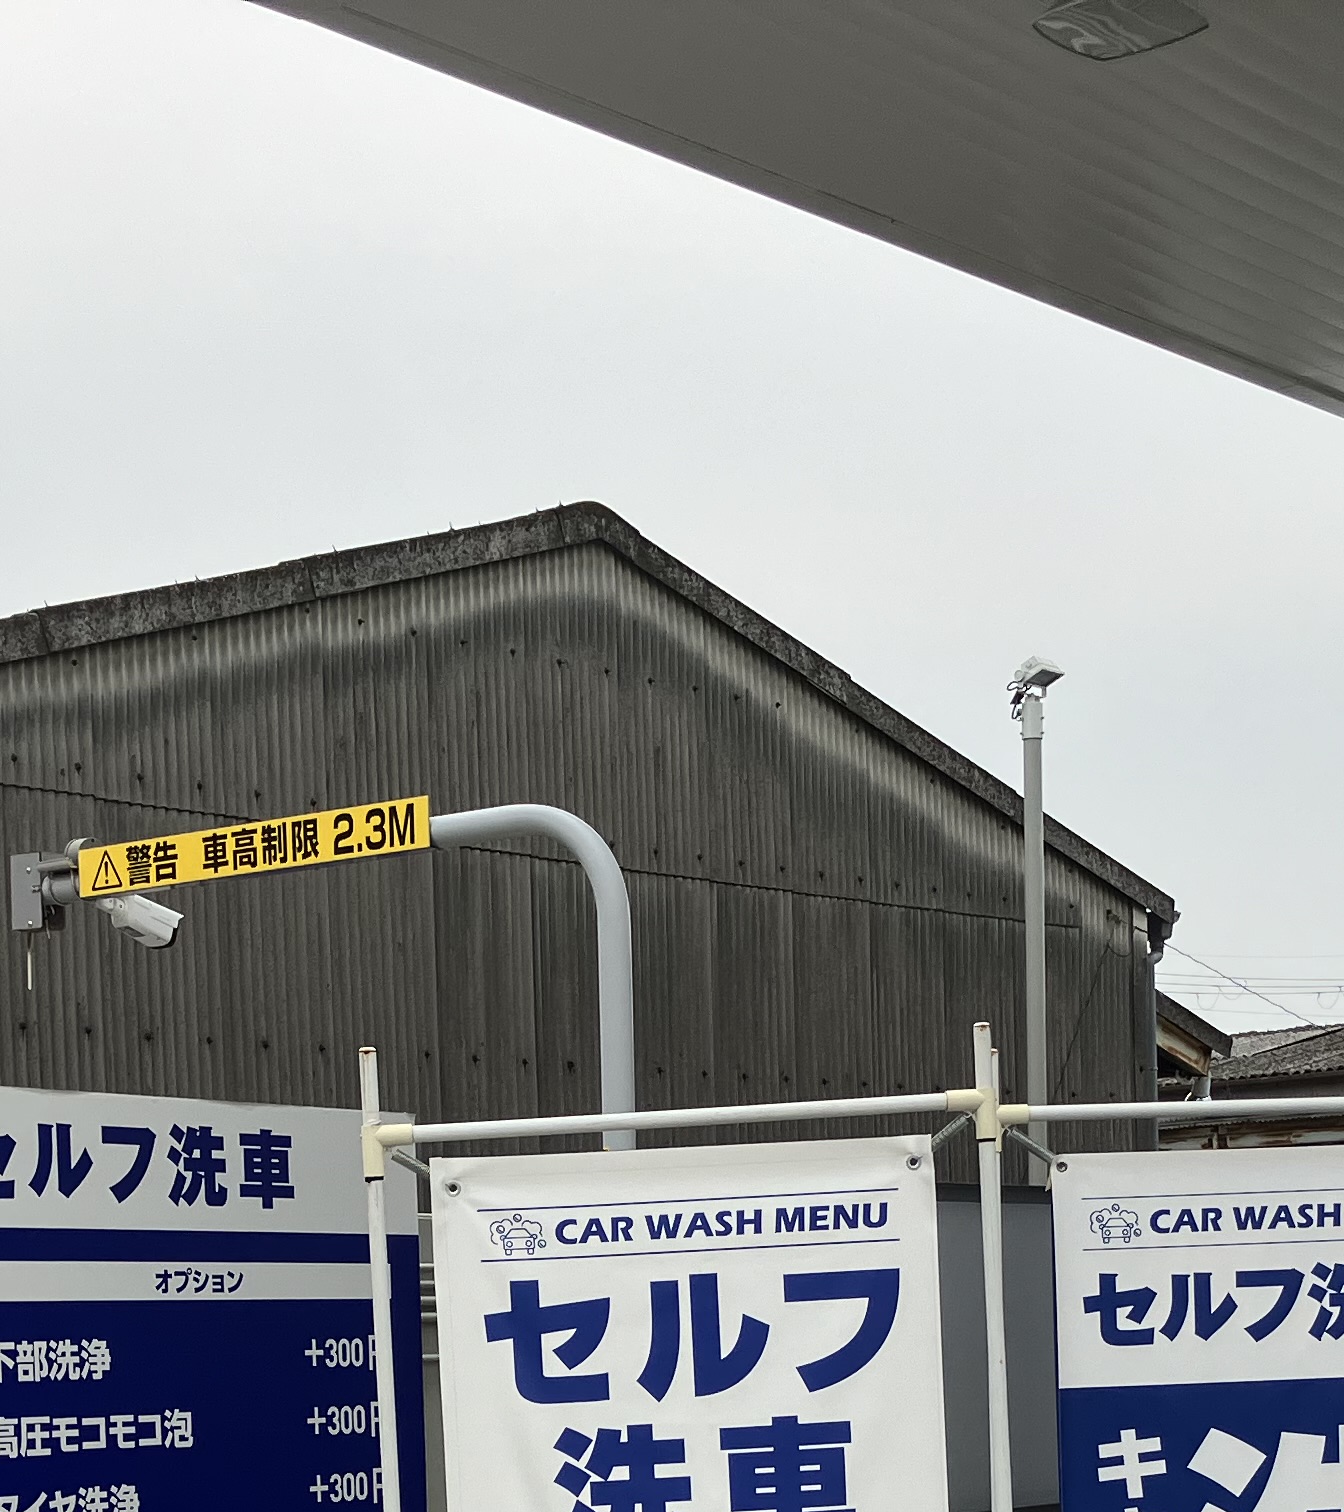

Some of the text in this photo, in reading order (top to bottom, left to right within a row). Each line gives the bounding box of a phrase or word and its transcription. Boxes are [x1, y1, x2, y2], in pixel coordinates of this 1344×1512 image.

[126, 802, 416, 886] 警告 車高制限 2.3M
[555, 1202, 888, 1245] CAR WASH MENU
[1149, 1207, 1223, 1234] CAR
[1233, 1202, 1341, 1231] WASH
[155, 1269, 244, 1294] オプション
[484, 1268, 900, 1404] セルフ
